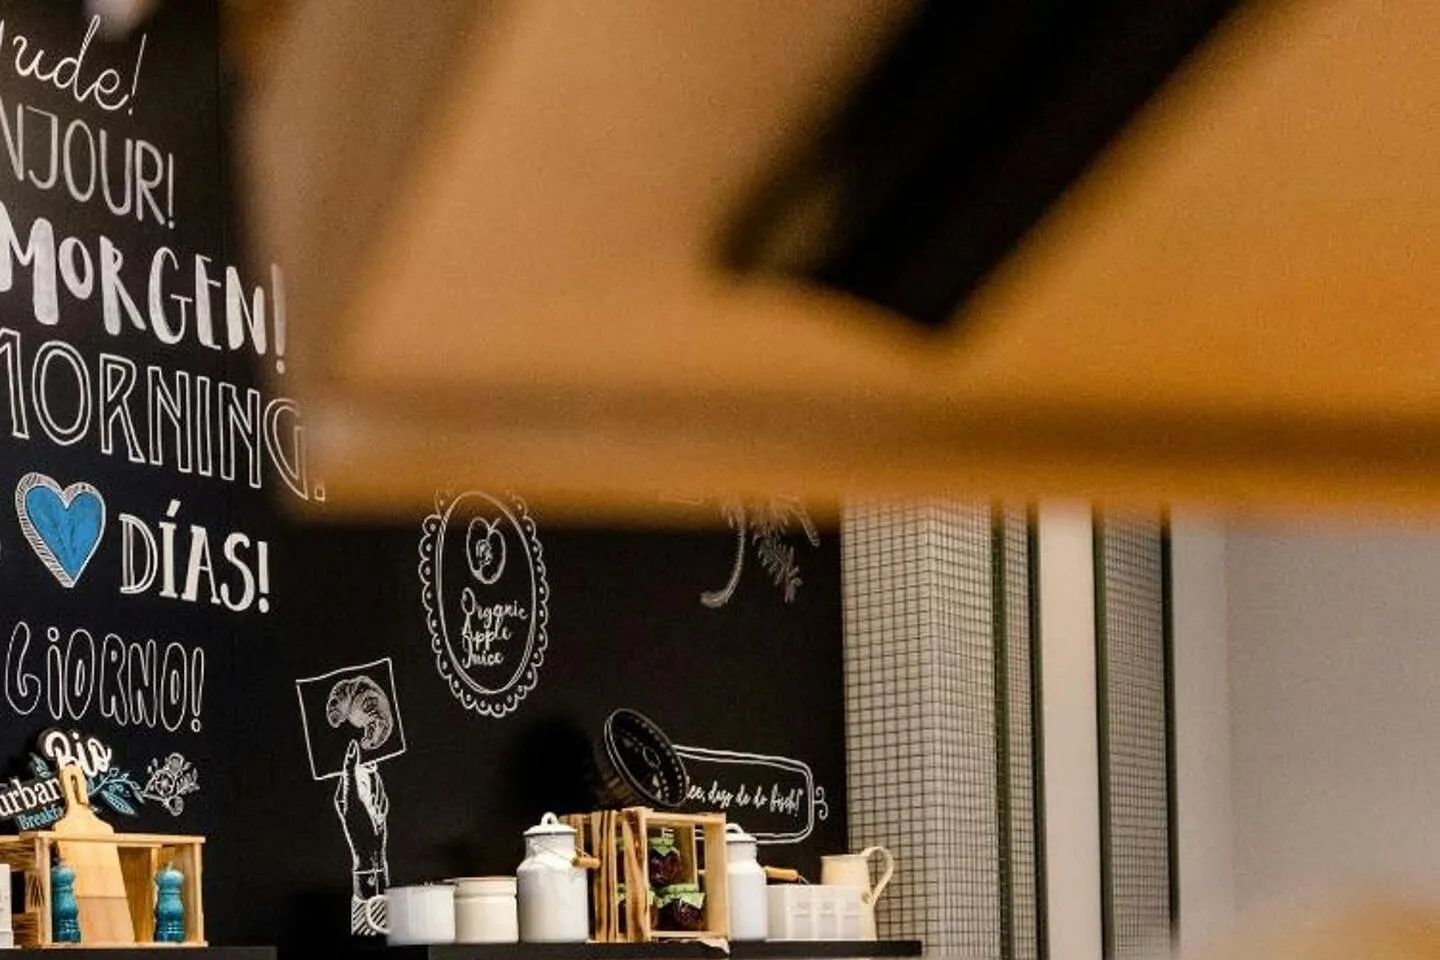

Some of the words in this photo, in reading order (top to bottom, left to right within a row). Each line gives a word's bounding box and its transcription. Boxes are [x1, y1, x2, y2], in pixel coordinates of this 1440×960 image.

[118, 499, 270, 613] DÍAS!
[461, 587, 528, 629] Organic
[462, 614, 512, 652] Apple
[462, 634, 504, 669] Juice
[44, 731, 112, 778] Bio
[17, 805, 64, 831] Breakf
